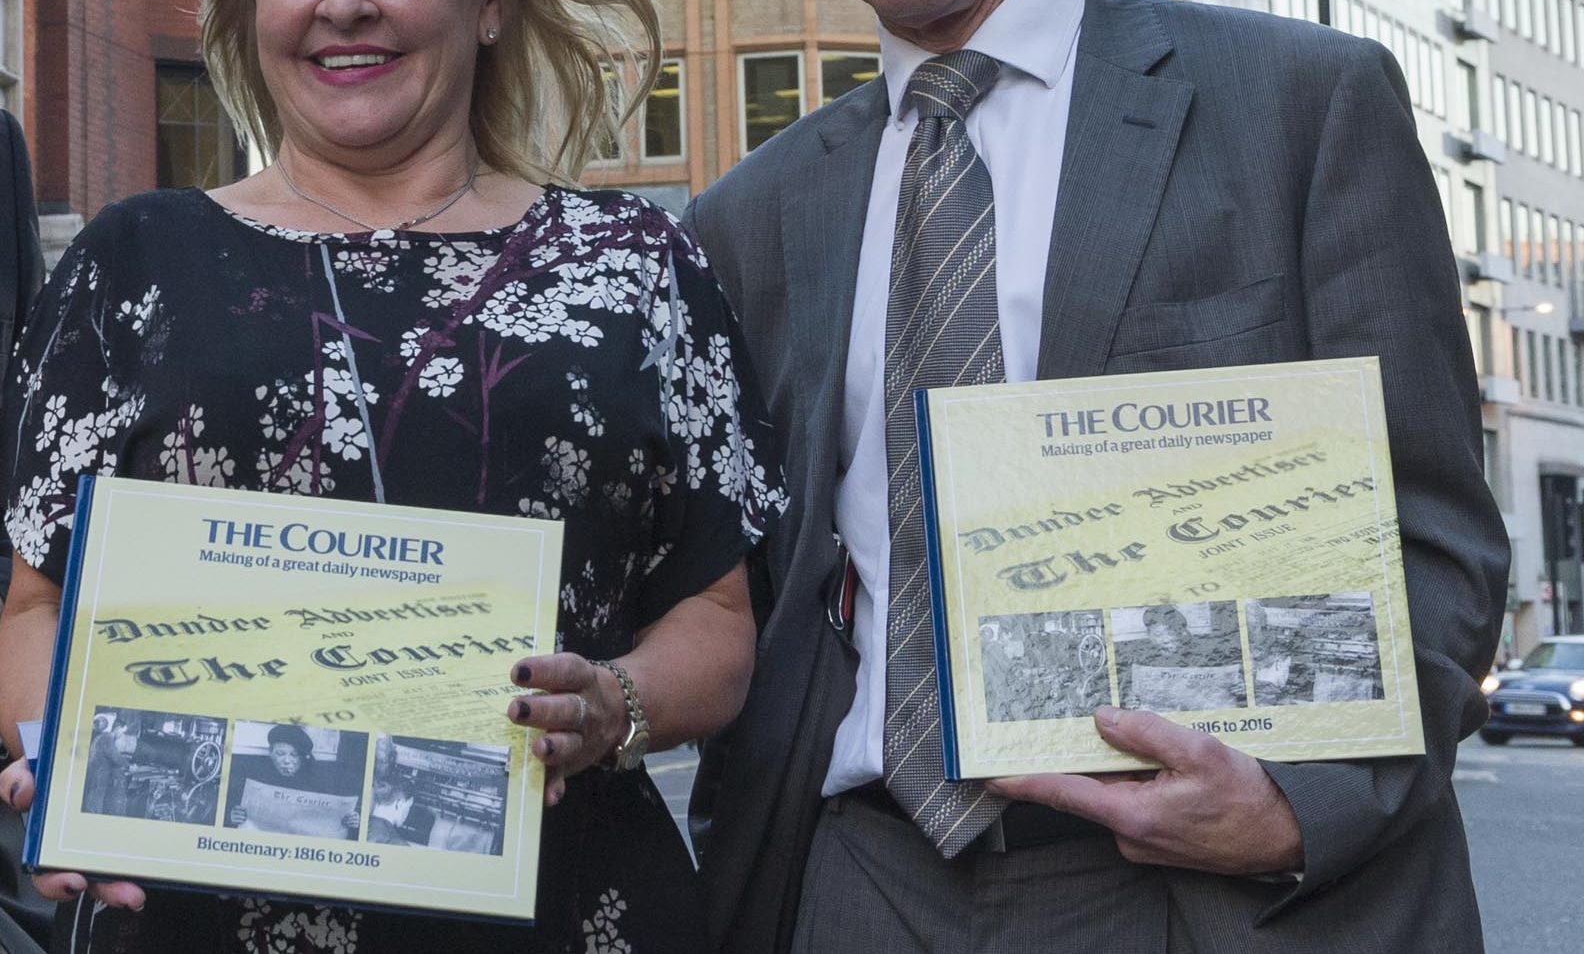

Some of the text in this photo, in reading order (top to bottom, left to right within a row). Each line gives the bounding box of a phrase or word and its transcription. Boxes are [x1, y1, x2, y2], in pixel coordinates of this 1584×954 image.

[1036, 397, 1273, 438] THE COURIER
[1041, 430, 1274, 458] Making of a great daily newspaper
[957, 449, 1328, 555] Dundee Advertiser
[1171, 503, 1203, 516] AND
[202, 518, 445, 566] THE COURIER
[995, 475, 1378, 591] The Courier
[1197, 537, 1246, 560] JOINT
[1250, 523, 1297, 542] ISSUE
[199, 549, 442, 585] Making of a great daily newspaper
[1185, 581, 1221, 596] TO
[93, 599, 493, 644] Dundee Advertiser
[321, 630, 354, 641] AND
[124, 634, 536, 689] The Courier
[338, 665, 446, 688] JOINT ISSUE
[317, 708, 356, 725] TO
[1223, 721, 1237, 733] to
[1239, 717, 1274, 732] 2016
[196, 836, 381, 868] Bicentenary: 1816 to 2016
